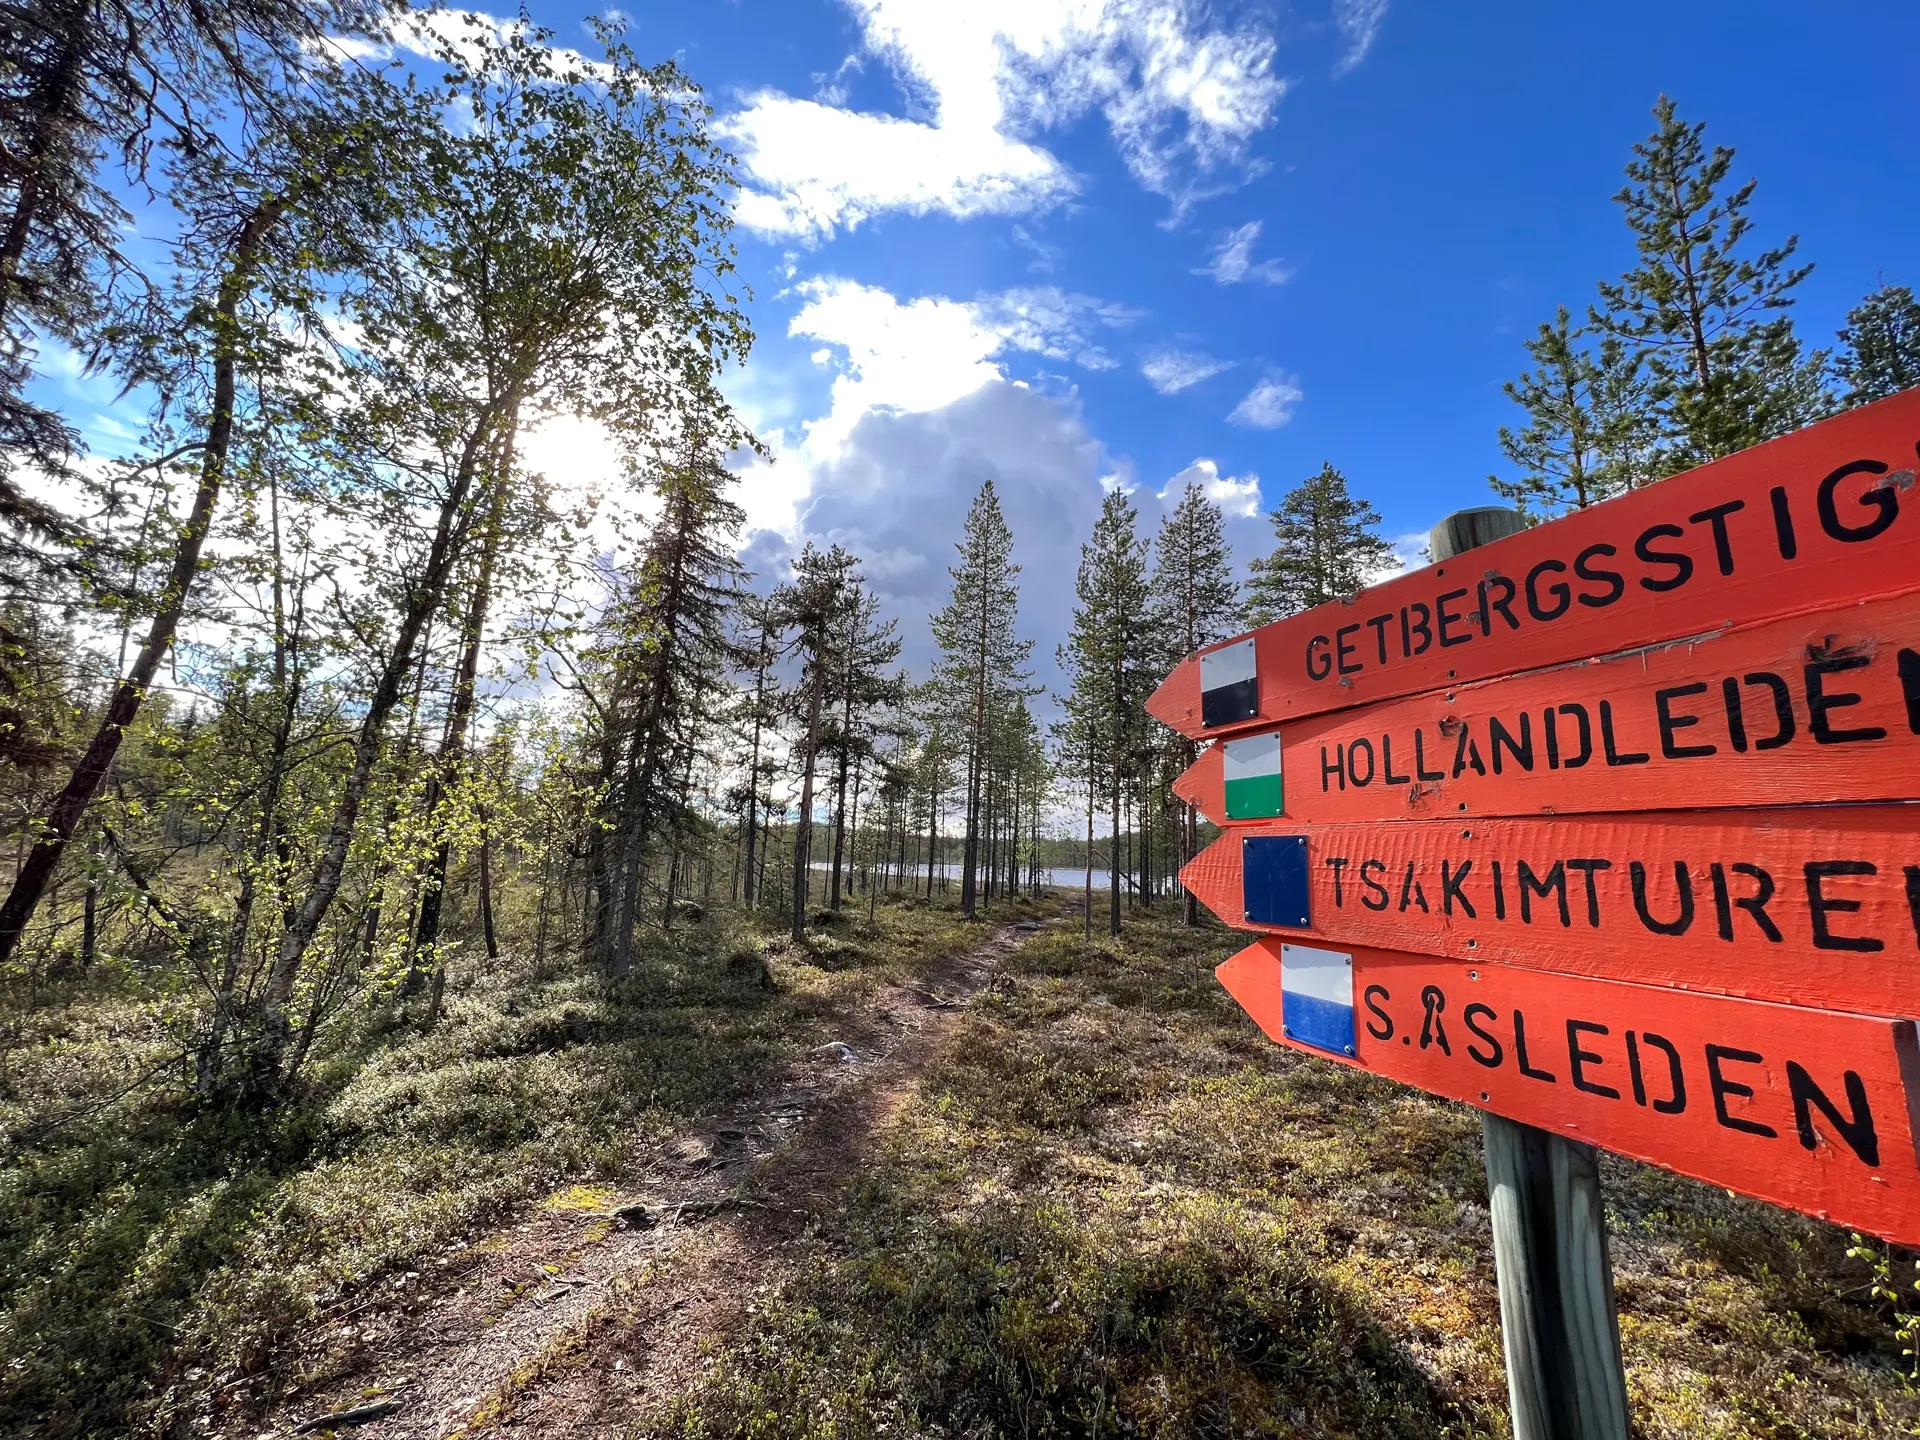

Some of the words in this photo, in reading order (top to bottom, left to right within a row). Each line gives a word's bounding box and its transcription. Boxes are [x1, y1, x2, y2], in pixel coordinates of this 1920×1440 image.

[1306, 440, 1920, 681] GETBERGSSTIG
[1320, 647, 1920, 792] HOLLANDLEDE
[1325, 857, 1920, 953] TSAKIMTURE
